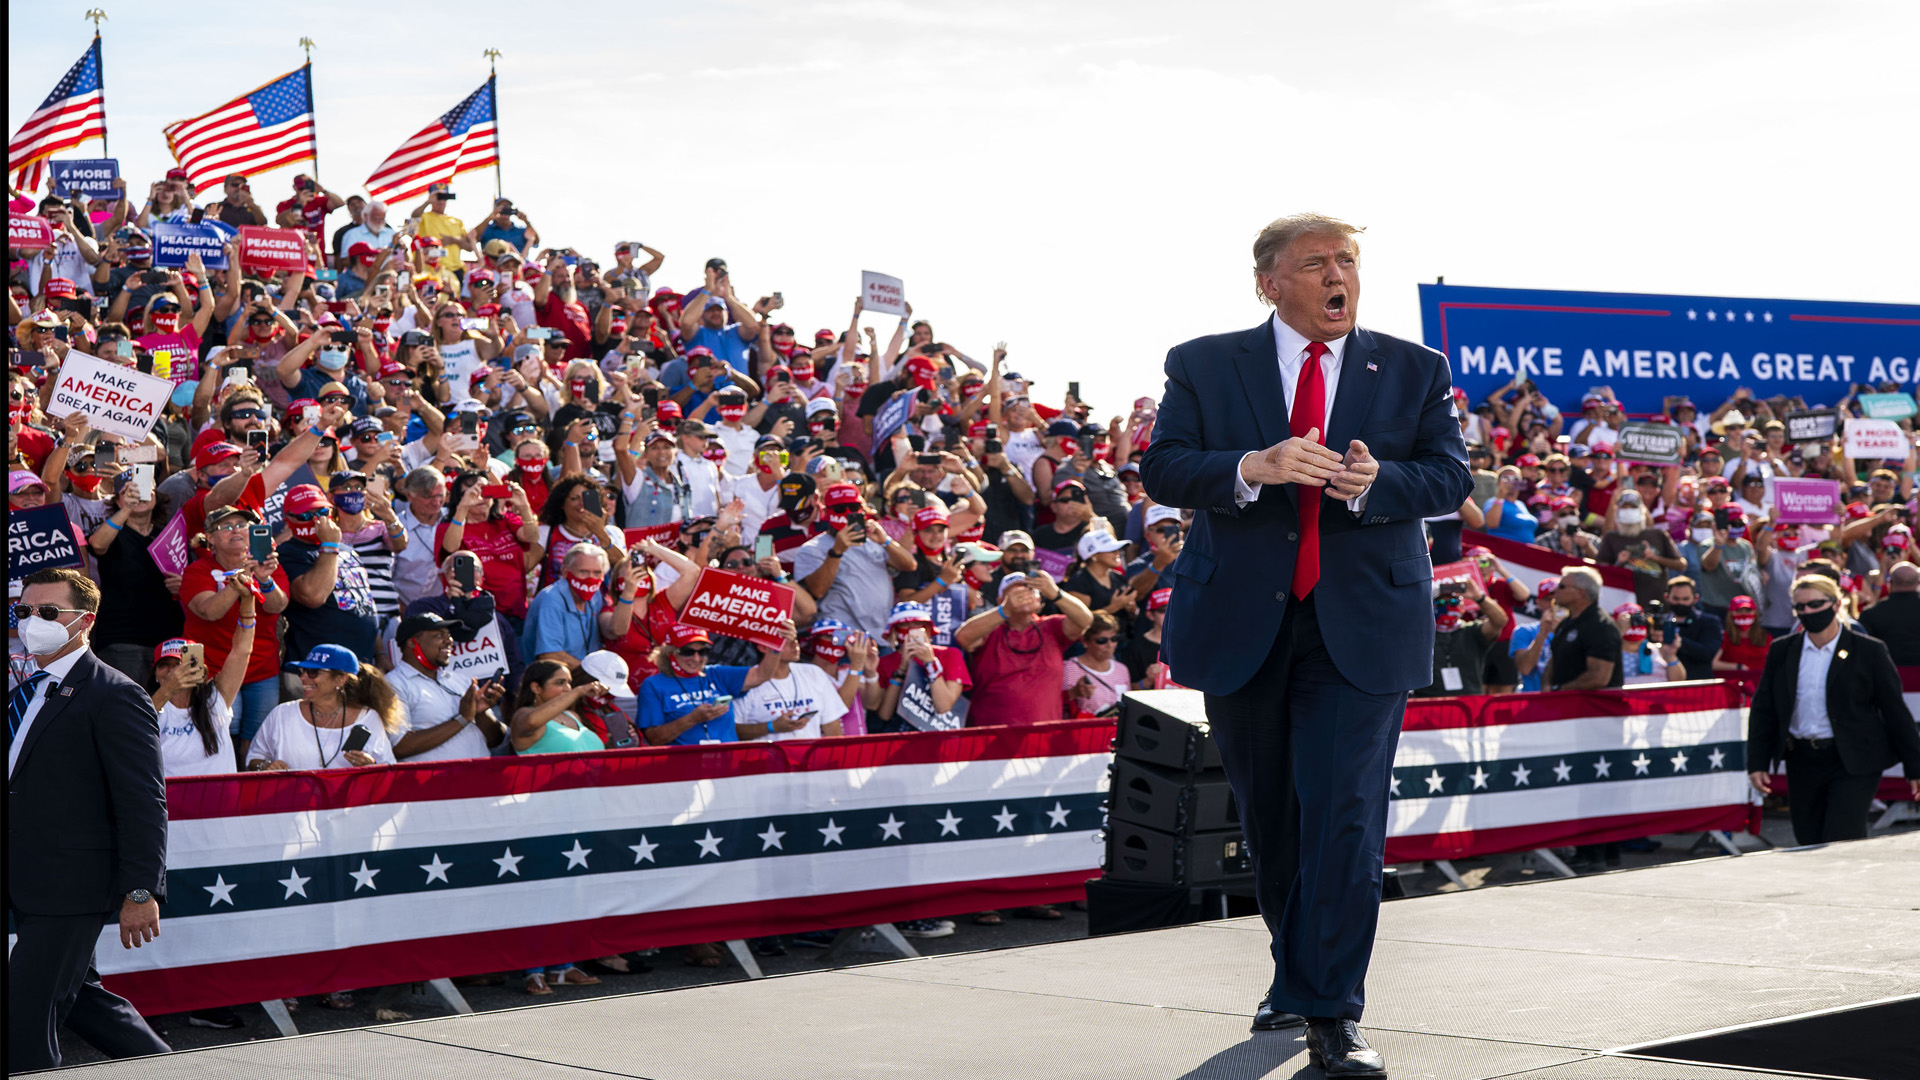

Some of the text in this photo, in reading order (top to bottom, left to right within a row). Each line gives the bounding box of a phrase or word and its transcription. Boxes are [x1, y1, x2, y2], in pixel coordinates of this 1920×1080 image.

[60, 169, 112, 179] 4 MORE
[62, 180, 111, 191] YEARS!
[9, 218, 41, 228] ORE
[161, 235, 223, 247] PEACEFUL
[247, 238, 301, 250] PEACEFUL
[161, 247, 221, 257] PROTESTER
[247, 249, 301, 261] PROTESTER
[1460, 345, 1564, 376] MAKE
[1578, 348, 1741, 380] AMERICA
[1751, 352, 1855, 382] GREAT
[93, 371, 137, 392] MAKE
[61, 376, 153, 416] AMERICA
[57, 392, 148, 429] GREAT AGAIN
[1627, 433, 1676, 447] VETERANS
[1781, 492, 1833, 505] Women
[830, 514, 847, 524] MA
[19, 545, 74, 566] AGAIN
[729, 584, 771, 603] MAKE
[694, 591, 787, 624] AMERICA
[688, 606, 738, 626] GREAT
[453, 652, 499, 671] AGAIN
[902, 697, 929, 722] GREAT
